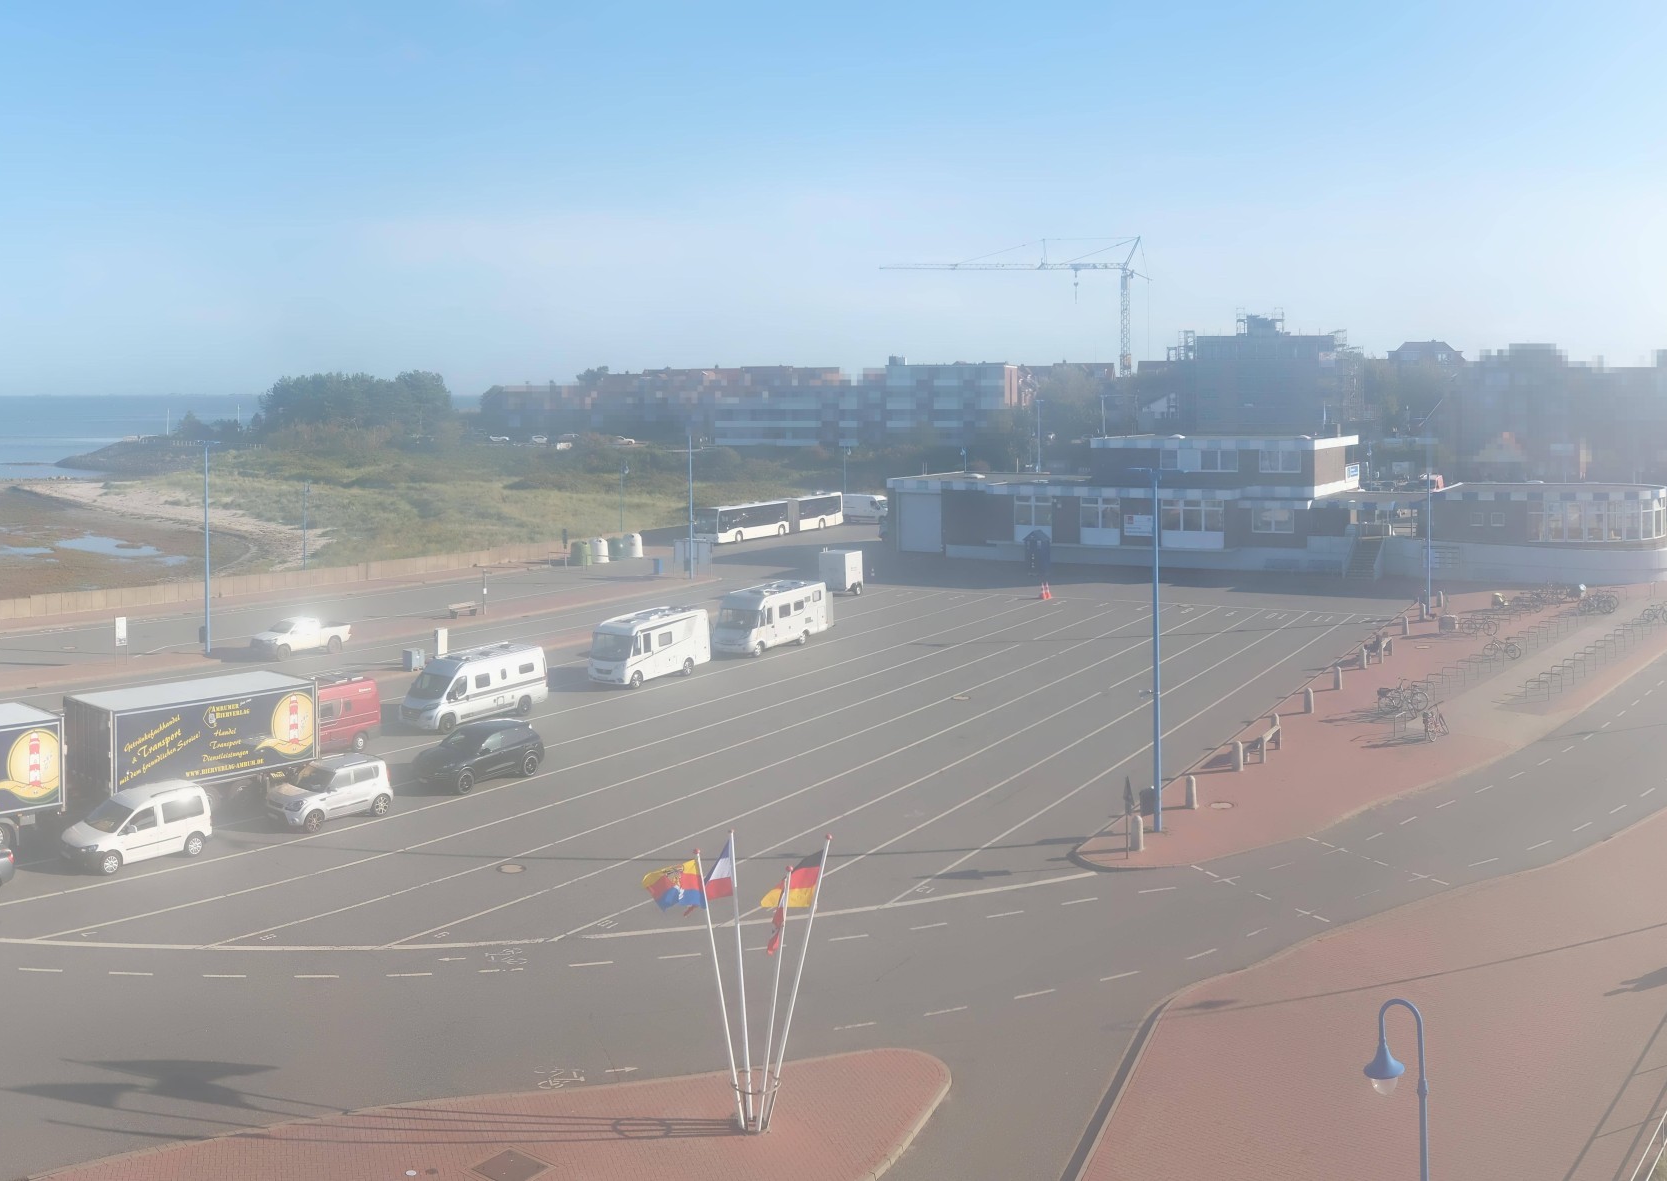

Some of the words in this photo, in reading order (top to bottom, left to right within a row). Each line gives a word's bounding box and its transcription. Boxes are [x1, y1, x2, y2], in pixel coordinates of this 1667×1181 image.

[215, 708, 251, 720] BIERVERLAG
[214, 727, 237, 737] Handel
[138, 728, 182, 758] Transport
[209, 738, 241, 751] Transport
[130, 766, 142, 779] dem
[142, 747, 177, 774] freundlichen
[202, 750, 249, 763] Dienstleistungen
